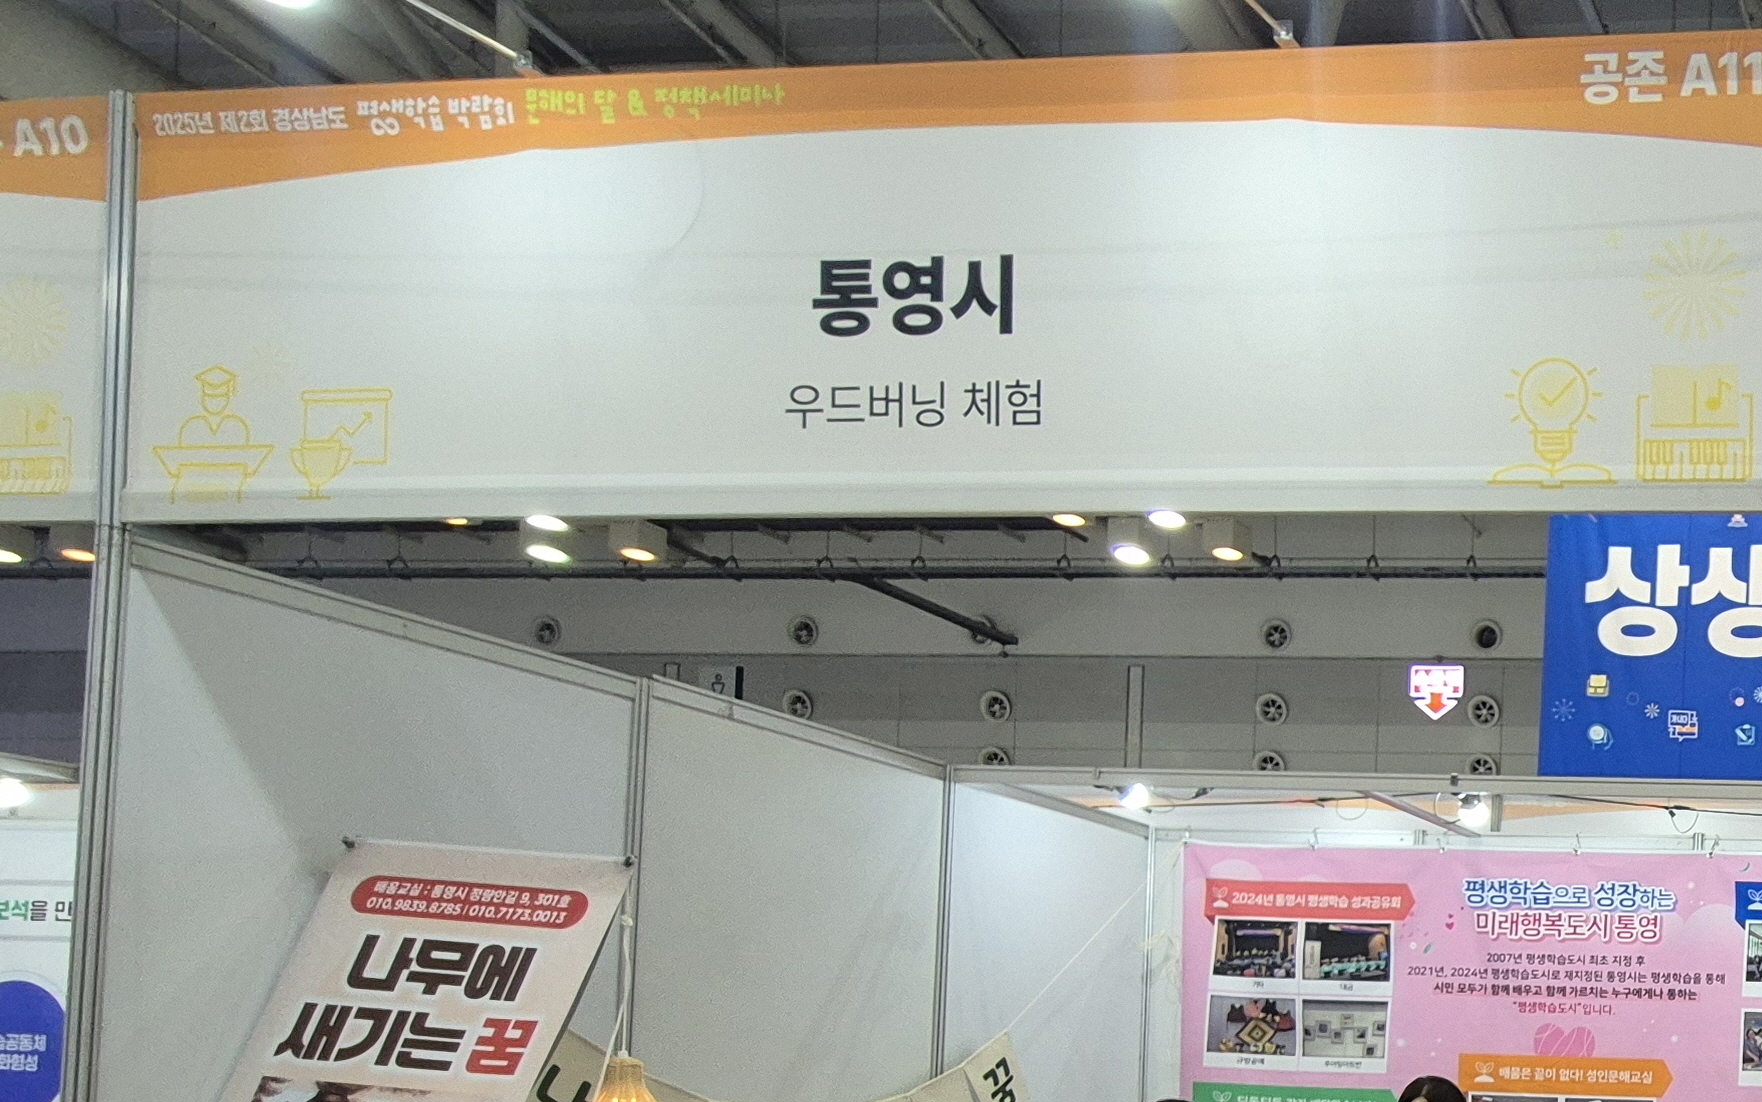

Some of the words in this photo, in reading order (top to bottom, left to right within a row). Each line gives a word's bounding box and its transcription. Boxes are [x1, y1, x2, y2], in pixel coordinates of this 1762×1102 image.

[1579, 50, 1668, 104] 공존
[152, 111, 215, 136] 2025년
[218, 108, 270, 133] 제2회
[271, 105, 349, 131] 경상남도
[355, 95, 446, 136] 평생학습
[447, 93, 515, 130] 박람회
[627, 88, 649, 117] &
[13, 115, 88, 157] A10
[811, 253, 1016, 338] 통영시
[784, 379, 947, 430] 우드버닝
[961, 378, 1044, 428] 체험
[1463, 878, 1590, 908] 평생학습으로
[1593, 881, 1675, 911] 성장하는
[1474, 911, 1610, 941] 미래행복도시
[1614, 912, 1660, 941] 통영
[346, 933, 538, 1002] 나무에
[1407, 966, 1448, 979] 2021년,
[1450, 967, 1489, 979] 2024년
[1490, 968, 1562, 981] 평생학습도시로
[1563, 969, 1603, 982] 재지정된
[1605, 970, 1649, 984] 통영시는
[1650, 971, 1702, 985] 평생학습을
[1704, 973, 1726, 985] 통해
[1486, 952, 1523, 965] 2007년
[1525, 954, 1586, 967] 평생학습도시
[1588, 954, 1609, 966] 최초
[1611, 955, 1633, 967] 지정
[1635, 955, 1646, 966] 후
[1433, 982, 1454, 994] 시민
[1456, 983, 1488, 995] 모두가
[1490, 984, 1511, 996] 함께
[1512, 984, 1543, 997] 배우고
[1545, 985, 1567, 998] 함께
[1568, 986, 1610, 999] 가르치는
[1611, 987, 1664, 1000] 누구에게나
[1666, 988, 1698, 1001] 통하는
[272, 1001, 467, 1072] 새기는
[464, 1016, 539, 1076] 꿈
[1586, 1070, 1653, 1084] 성인문해교실
